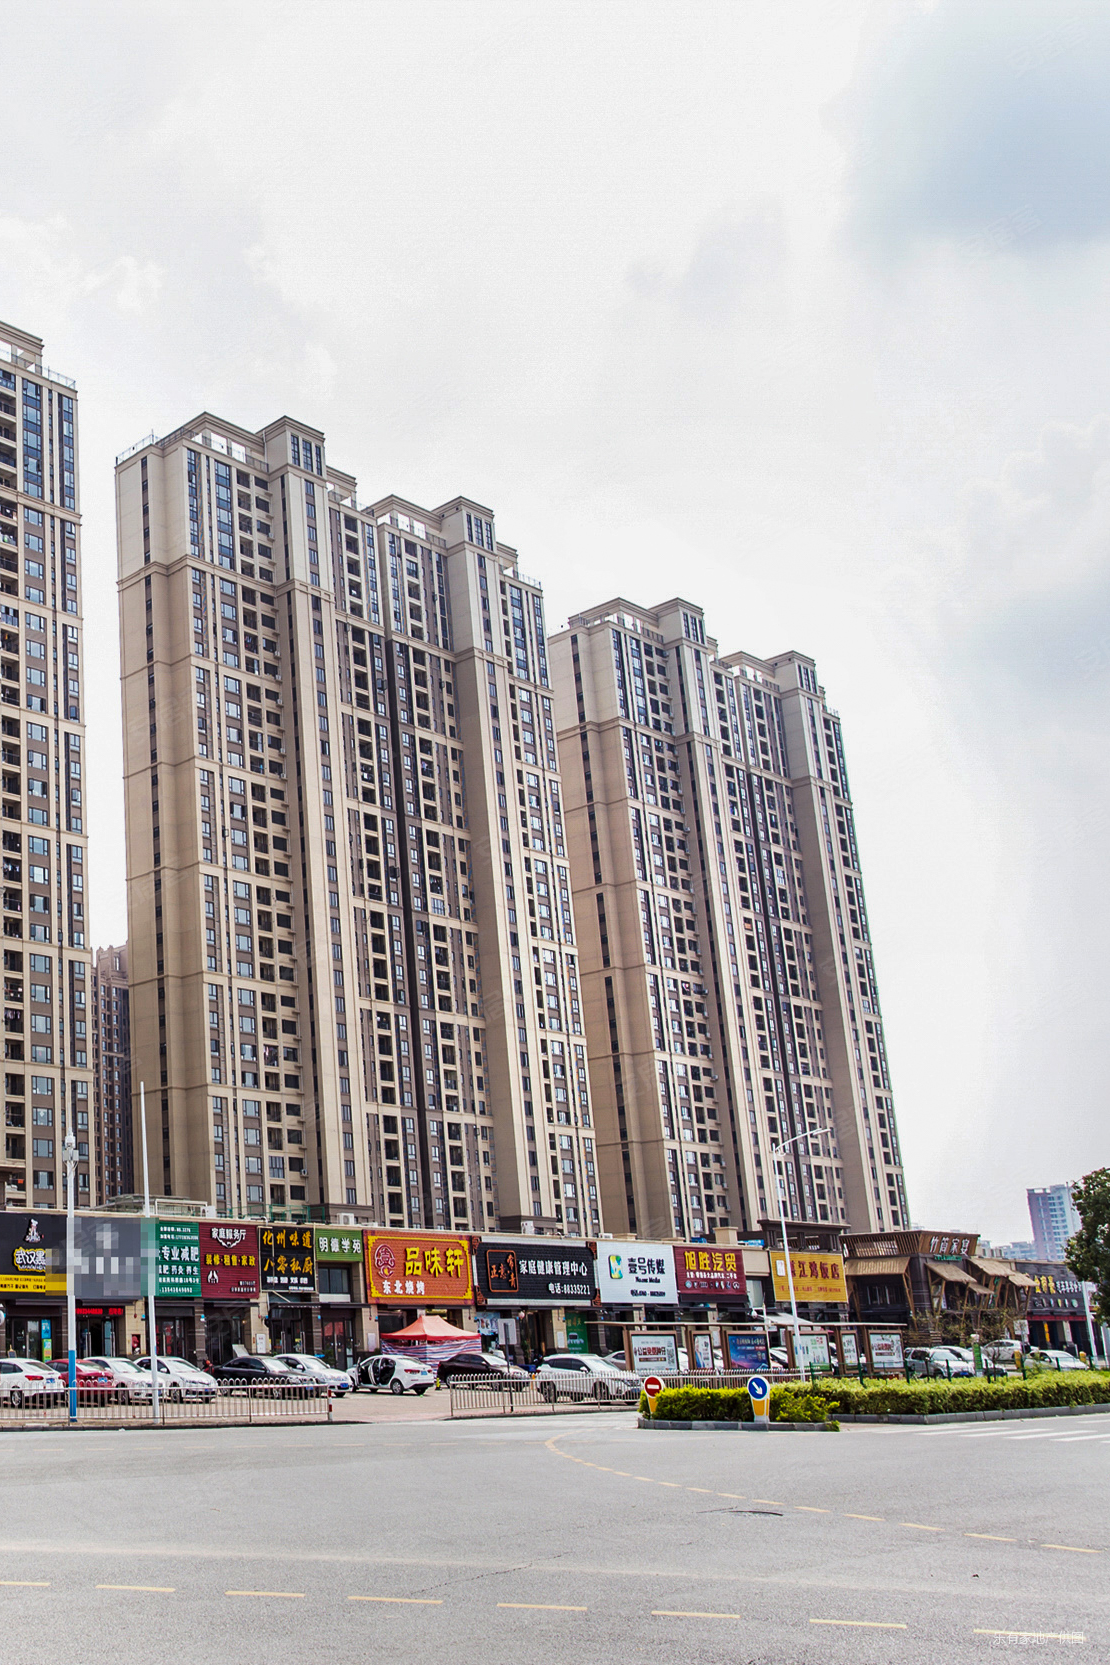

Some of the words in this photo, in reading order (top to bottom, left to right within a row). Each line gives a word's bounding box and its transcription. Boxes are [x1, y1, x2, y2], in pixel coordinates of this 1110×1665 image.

[211, 1228, 246, 1240] 家庭服务厅
[263, 1229, 312, 1249] 化州味道
[318, 1237, 362, 1254] 明德学苑
[405, 1246, 464, 1278] 品味轩
[519, 1260, 588, 1277] 家庭健康管理中心
[628, 1257, 666, 1275] 壹号传媒
[684, 1251, 737, 1272] 旭胜汽贸
